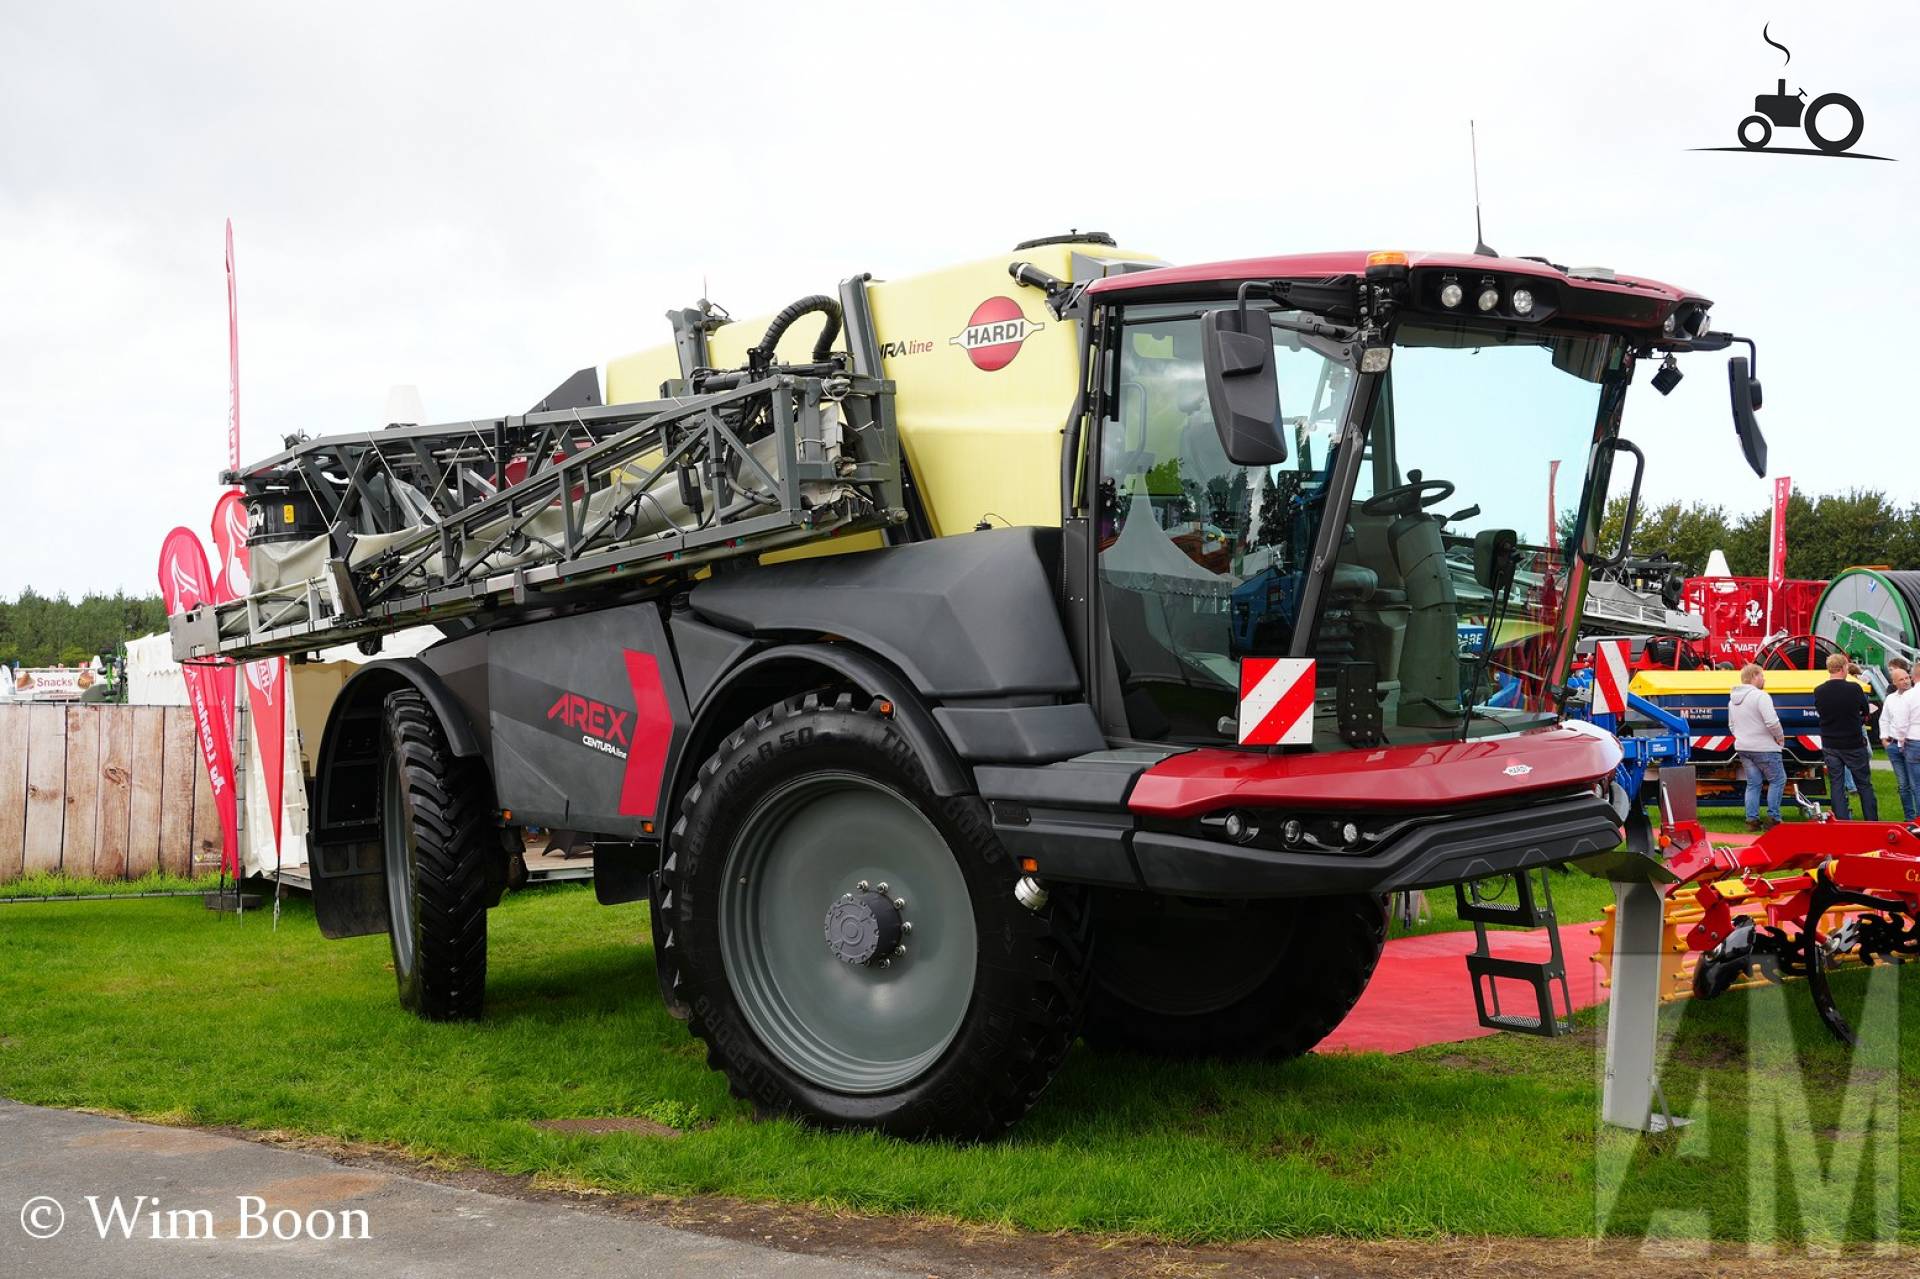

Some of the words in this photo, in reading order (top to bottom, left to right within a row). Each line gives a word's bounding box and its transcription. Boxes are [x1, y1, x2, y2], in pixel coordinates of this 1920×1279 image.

[967, 322, 1025, 346] HARDI
[1720, 643, 1758, 653] VEVAET
[36, 677, 73, 688] Snacks
[547, 691, 629, 747] AREX
